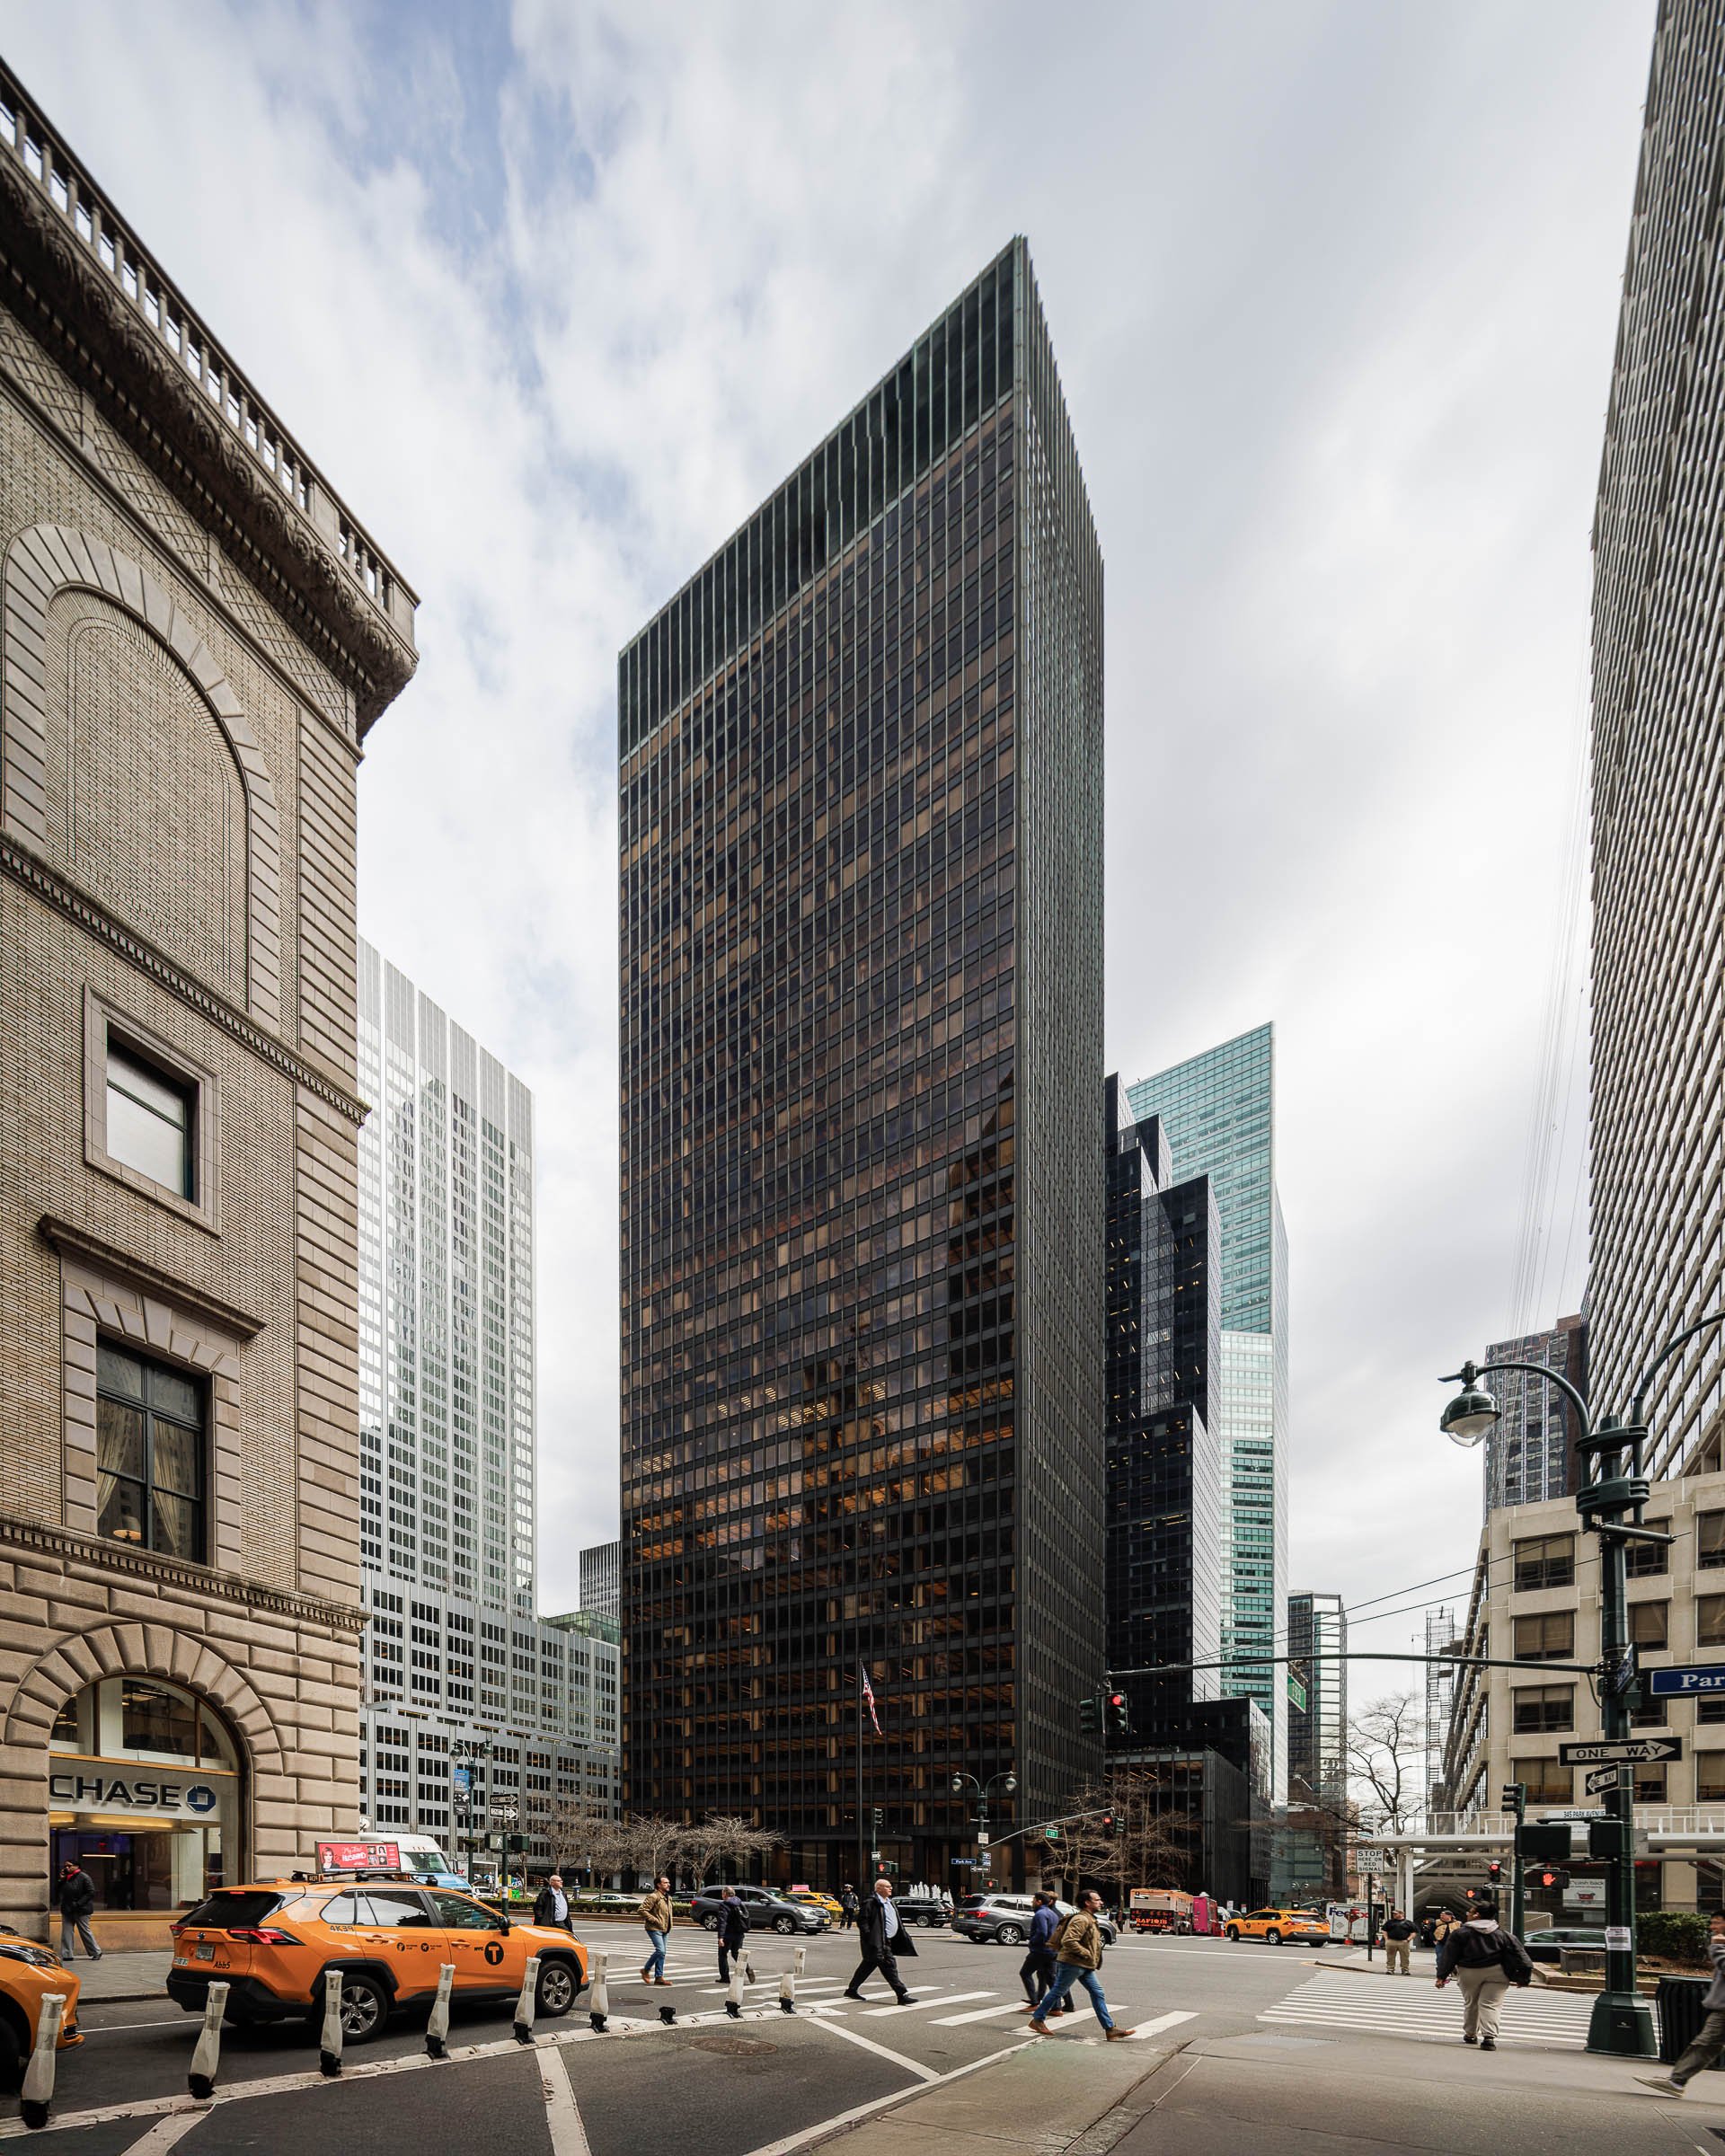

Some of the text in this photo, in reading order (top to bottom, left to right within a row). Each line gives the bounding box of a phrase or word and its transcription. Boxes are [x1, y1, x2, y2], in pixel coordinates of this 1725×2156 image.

[1576, 1745, 1663, 1759] ONE WAY
[1590, 1772, 1614, 1788] ONE WAY
[49, 1774, 182, 1807] CHASE
[1563, 1810, 1572, 1818] 345
[1573, 1810, 1584, 1818] PARK
